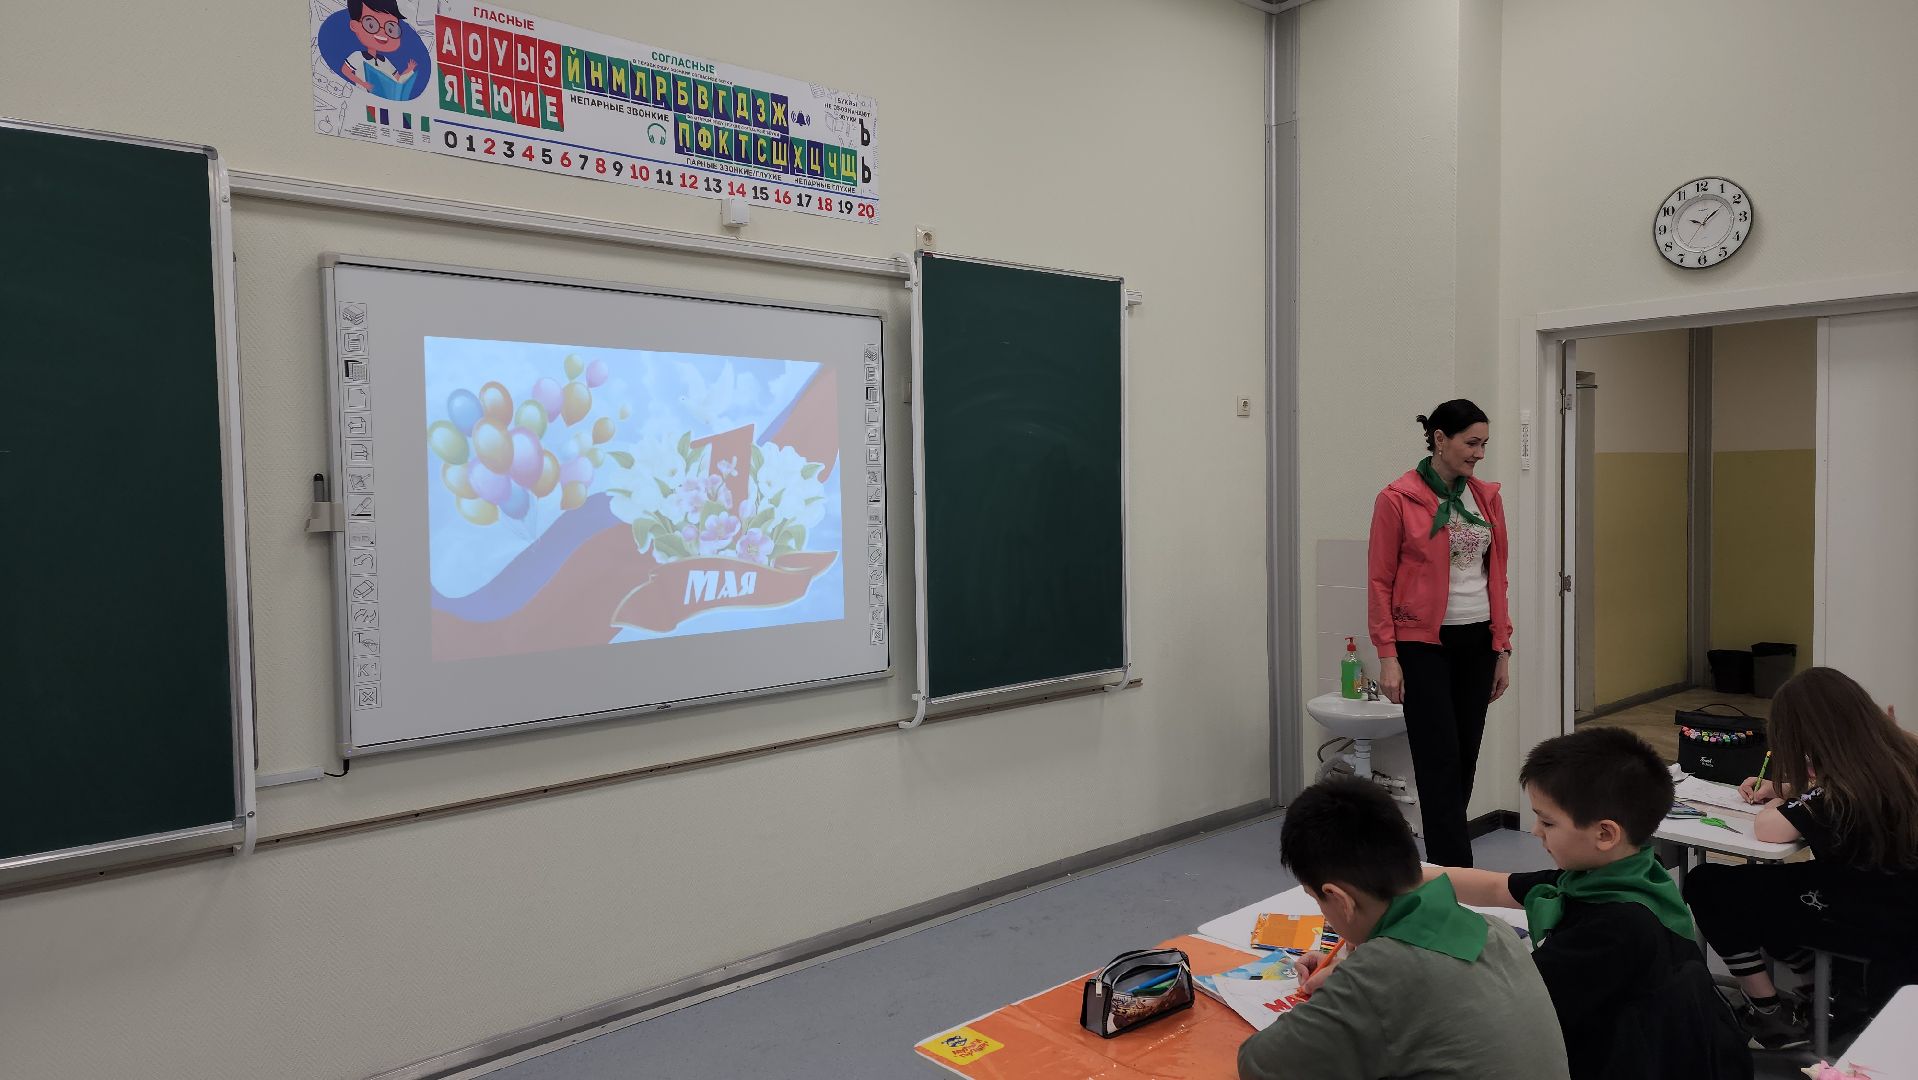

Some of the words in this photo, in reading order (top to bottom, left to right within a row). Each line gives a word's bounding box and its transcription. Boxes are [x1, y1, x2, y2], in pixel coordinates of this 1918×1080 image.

[473, 6, 535, 31] ГЛАСНЫЕ
[442, 26, 457, 57] А
[468, 32, 482, 62] О
[493, 37, 508, 67] У
[517, 43, 535, 74] Ы
[544, 50, 556, 78] Э
[651, 51, 715, 74] СОГЛАСНЫЕ
[567, 47, 580, 85] Й
[590, 60, 603, 88] Н
[612, 66, 626, 94] М
[635, 71, 647, 98] Л
[656, 75, 666, 101] Р
[677, 80, 688, 106] Б
[697, 84, 708, 110] В
[718, 89, 728, 113] Г
[736, 93, 749, 119] Д
[757, 97, 765, 123] З
[772, 101, 787, 127] Ж
[444, 75, 458, 104] Я
[470, 77, 485, 111] Ё
[493, 84, 512, 114] Ю
[521, 90, 535, 118] И
[546, 95, 558, 123] Е
[570, 94, 625, 113] НЕПАРНЫЕ
[626, 106, 670, 122] ЗВОНКИЕ
[859, 118, 871, 146] Ъ
[678, 122, 691, 148] П
[697, 126, 712, 151] Ф
[718, 129, 729, 155] К
[739, 134, 749, 159] Т
[757, 138, 767, 163] С
[771, 141, 788, 167] Ш
[793, 144, 803, 169] Х
[811, 147, 820, 174] Ц
[829, 152, 837, 176] Ч
[841, 153, 857, 180] Щ
[686, 157, 718, 170] ПАРНЫЕ
[862, 156, 871, 183] Ь
[444, 130, 458, 149] 0
[466, 135, 476, 152] 1
[483, 137, 496, 156] 2
[502, 140, 515, 159] 3
[521, 145, 535, 162] 4
[541, 148, 553, 165] 5
[560, 151, 572, 168] 6
[578, 154, 589, 170] 7
[595, 157, 606, 174] 8
[612, 160, 623, 177] 9
[630, 163, 650, 182] 10
[655, 168, 674, 186] 11
[679, 172, 699, 190] 12
[704, 177, 723, 194] 13
[727, 181, 747, 198] 14
[752, 185, 770, 202] 15
[774, 189, 792, 205] 16
[796, 193, 813, 208] 17
[817, 197, 833, 212] 18
[838, 200, 854, 215] 19
[857, 203, 875, 219] 20
[794, 178, 831, 190] НЕПАРНЫЕ
[831, 183, 856, 194] ГЛУХИЕ
[1696, 180, 1708, 193] 12
[1720, 183, 1725, 193] 1
[1677, 190, 1686, 201] 11
[1733, 193, 1741, 205] 2
[1662, 205, 1675, 217] 10
[1739, 211, 1748, 222] 3
[1659, 224, 1667, 235] 9
[1732, 231, 1740, 241] 4
[1665, 242, 1673, 252] 8
[1719, 246, 1728, 257] 5
[1678, 253, 1685, 264] 7
[1698, 255, 1707, 266] 6
[684, 570, 757, 605] МАЯ
